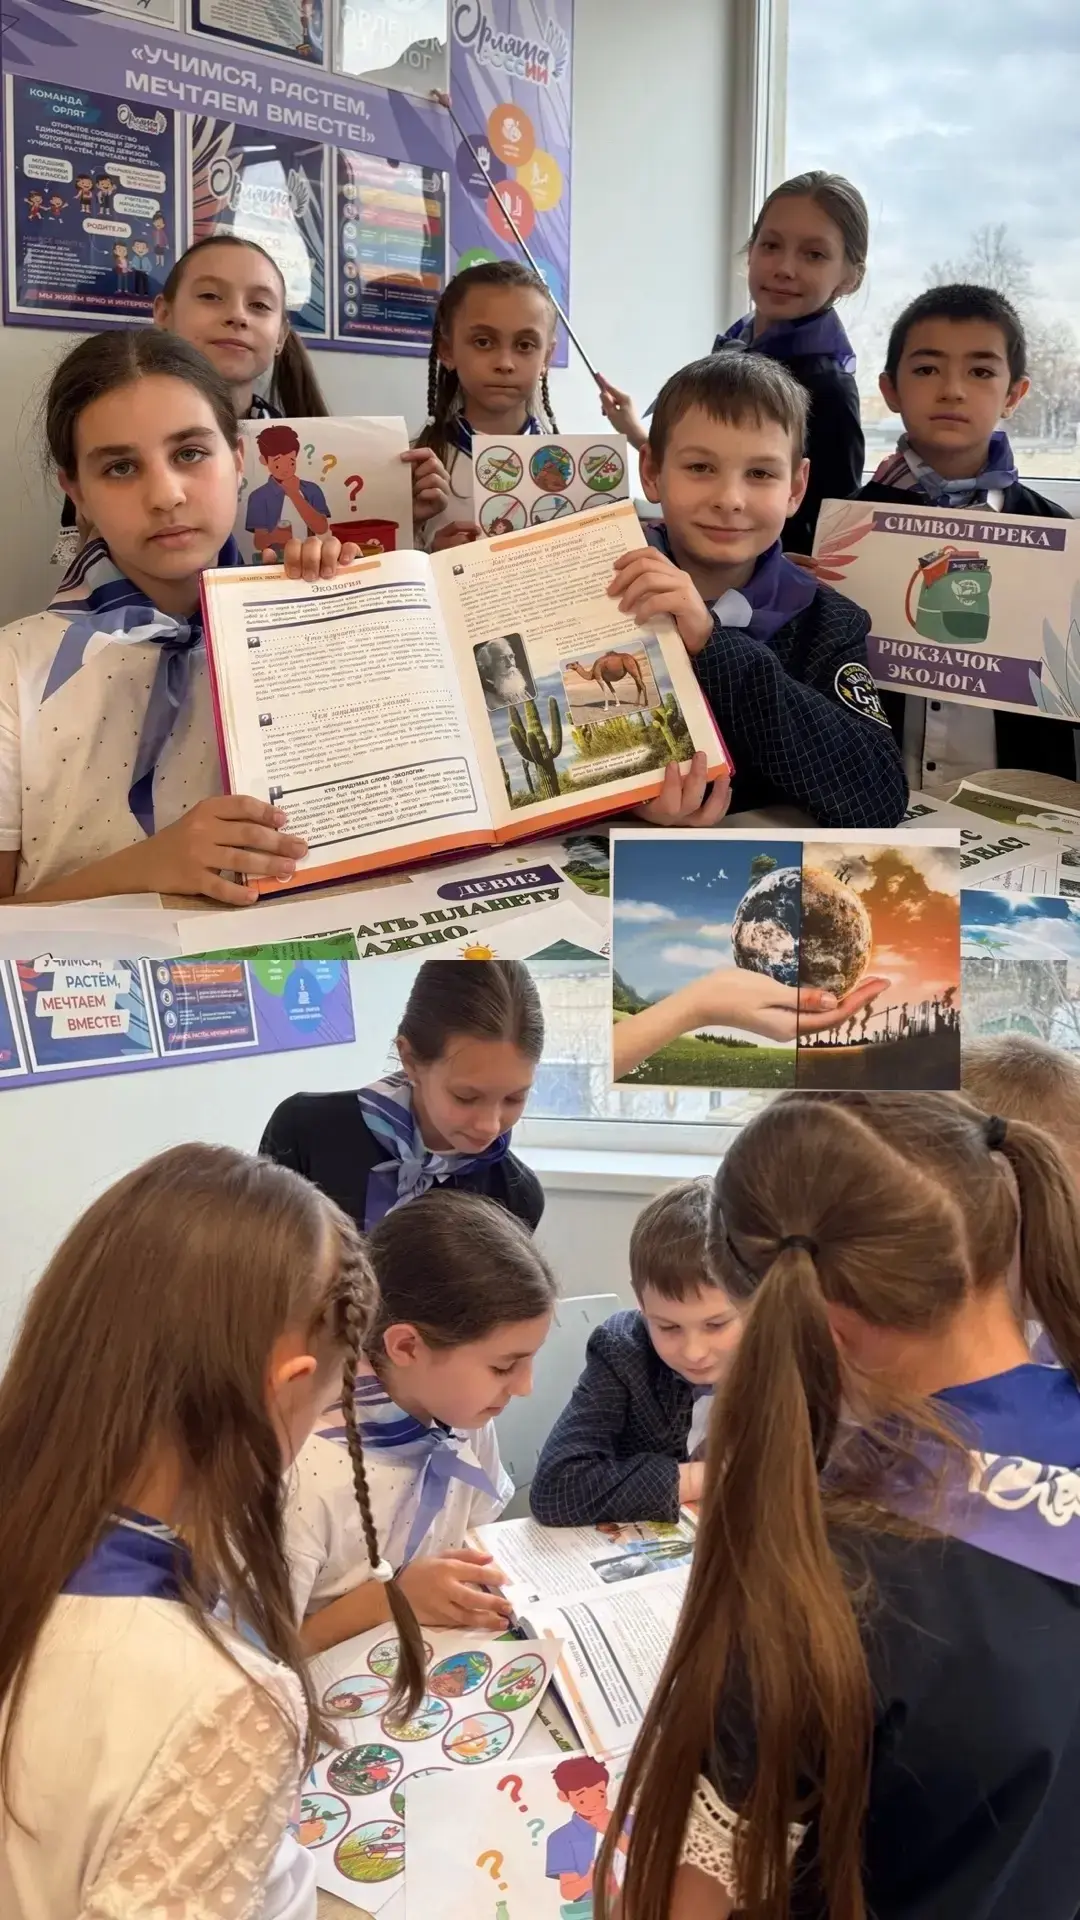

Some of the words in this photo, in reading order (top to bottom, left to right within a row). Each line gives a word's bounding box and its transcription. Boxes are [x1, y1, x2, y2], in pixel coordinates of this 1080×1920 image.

[455, 3, 550, 64] Орлята
[131, 44, 263, 94] «УЧИМСЯ,
[270, 77, 371, 120] РАСТЕМ,
[29, 88, 83, 106] КОМАНДА
[125, 69, 259, 118] МЕЧТАЕМ
[266, 103, 376, 143] ВМЕСТЕ!»
[52, 104, 87, 118] ОРЛЯТ
[39, 133, 73, 144] КОТОРОЕ
[51, 121, 89, 134] ОТКРЫТОЕ
[90, 128, 138, 143] СООБЩЕСТВО
[86, 222, 128, 233] РОДИТЕЛИ
[115, 299, 154, 309] ИНТЕРЕСН
[884, 516, 975, 539] СИМВОЛ
[979, 525, 1051, 546] ТРЕКА
[311, 580, 362, 593] Экология
[877, 639, 1003, 673] РЮКЗАЧОК
[887, 663, 988, 694] ЭКОЛОГА
[337, 780, 369, 790] ПРИДУМАЛ
[370, 775, 390, 784] СЛОВО
[459, 872, 542, 898] ДЕВИЗ
[419, 887, 560, 926] ПЛАНЕТУ
[65, 972, 121, 989] РАСТЁМ,
[41, 995, 106, 1011] МЕЧТАЕМ
[67, 1015, 121, 1032] ВМЕСТЕ!
